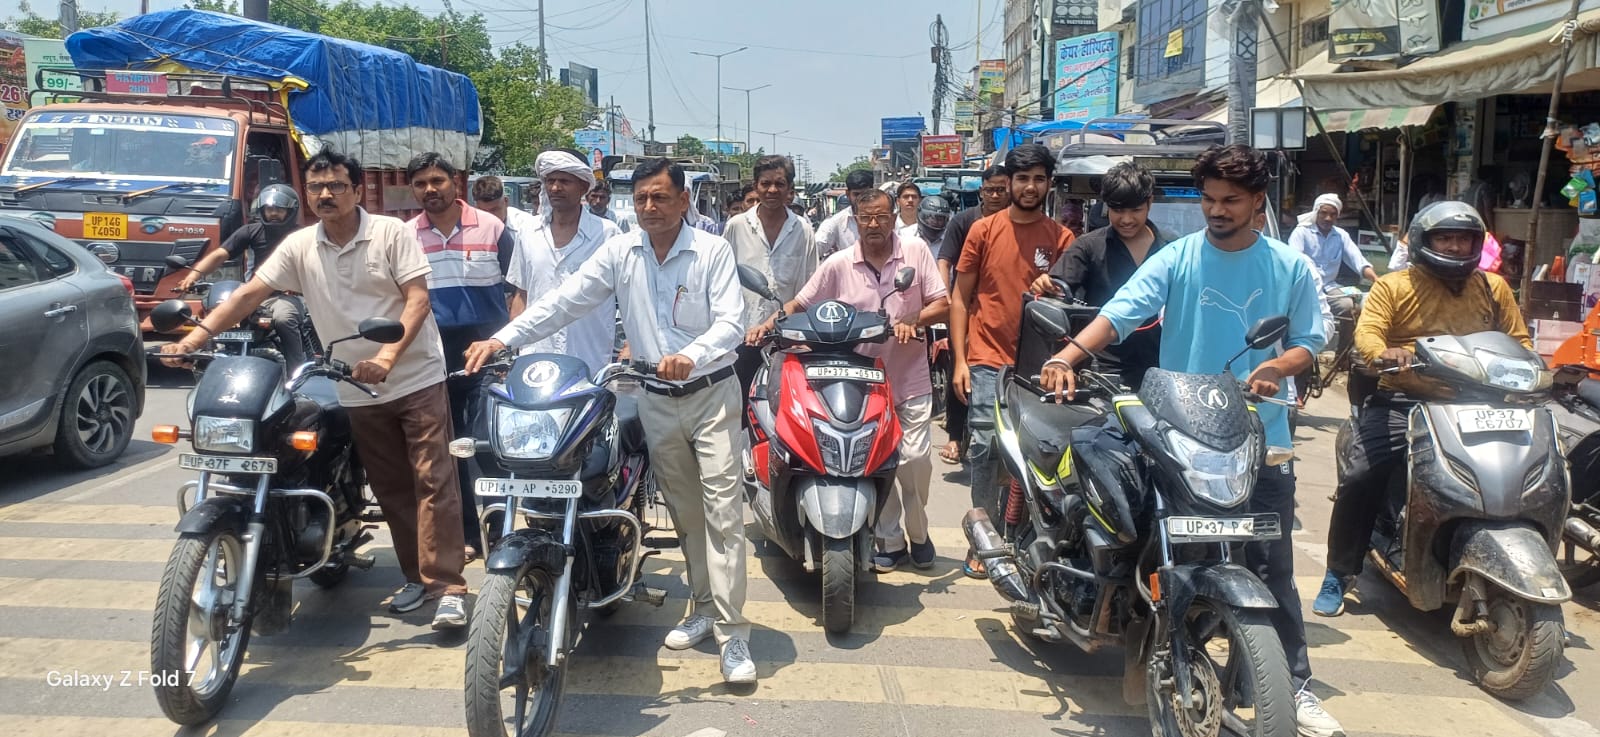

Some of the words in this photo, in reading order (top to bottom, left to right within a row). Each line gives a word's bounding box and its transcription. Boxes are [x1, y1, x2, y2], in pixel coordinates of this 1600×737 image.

[1060, 44, 1078, 60] केयर
[1081, 38, 1114, 57] हॉस्पिटल
[1, 84, 21, 102] 26
[91, 216, 121, 226] UP14G
[91, 226, 121, 237] T4050
[190, 456, 204, 467] UP
[480, 482, 506, 493] UP14
[522, 483, 536, 494] AP
[551, 484, 577, 494] 5290
[1186, 521, 1203, 534] UP
[1209, 521, 1225, 534] 37
